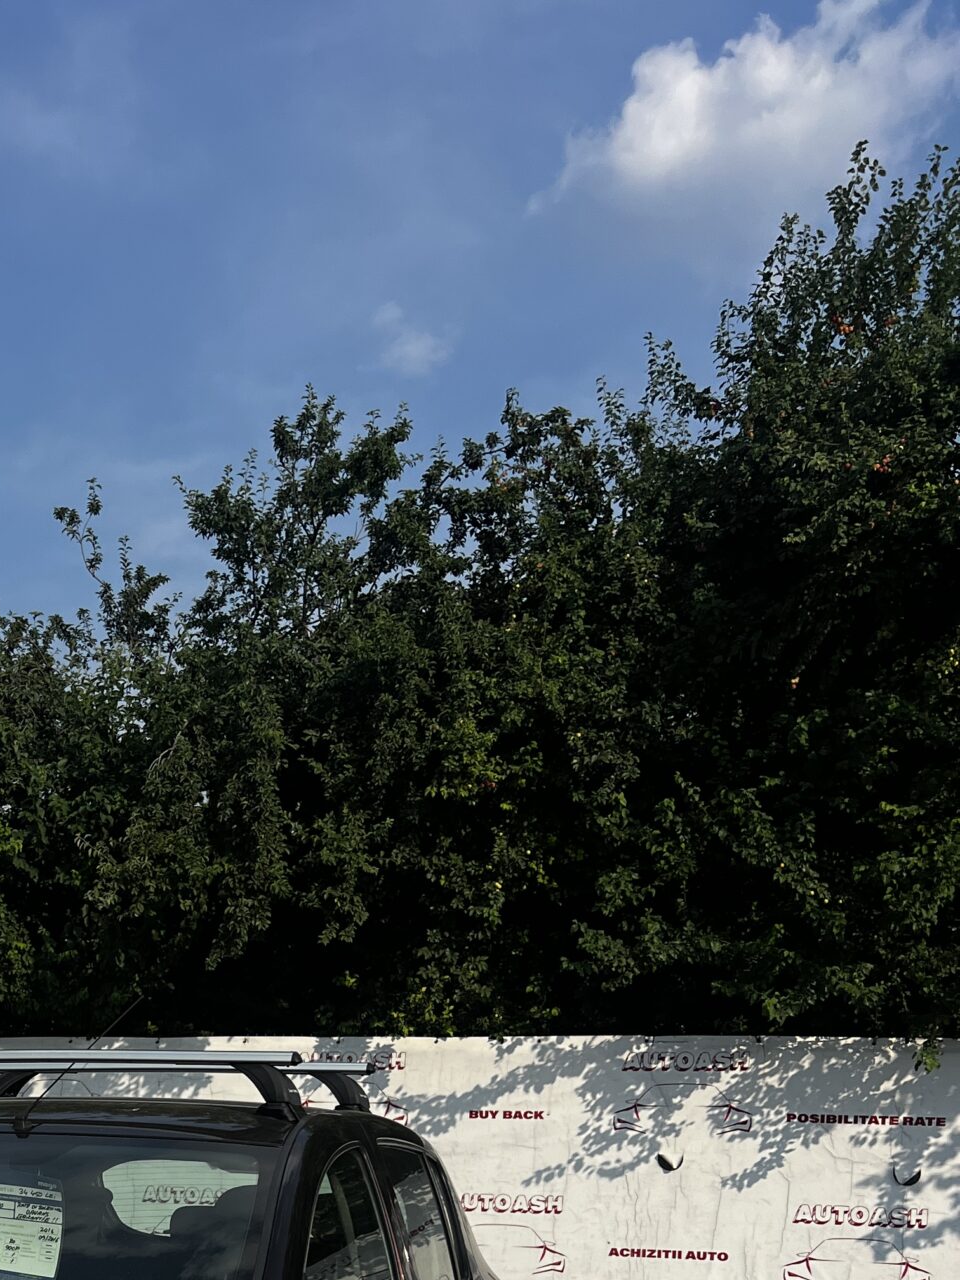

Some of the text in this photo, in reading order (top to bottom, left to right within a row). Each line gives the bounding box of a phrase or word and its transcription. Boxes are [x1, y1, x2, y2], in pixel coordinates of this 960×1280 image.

[622, 1051, 751, 1072] AUTOASH
[469, 1110, 545, 1120] BUY BACK
[786, 1113, 946, 1127] POSIBILITATE RATE
[19, 1188, 28, 1196] 34
[142, 1185, 223, 1205] AUTOA
[460, 1192, 563, 1214] UTOASH
[793, 1204, 929, 1229] AUTOASH
[608, 1247, 729, 1262] ACHIZITII AUTO
